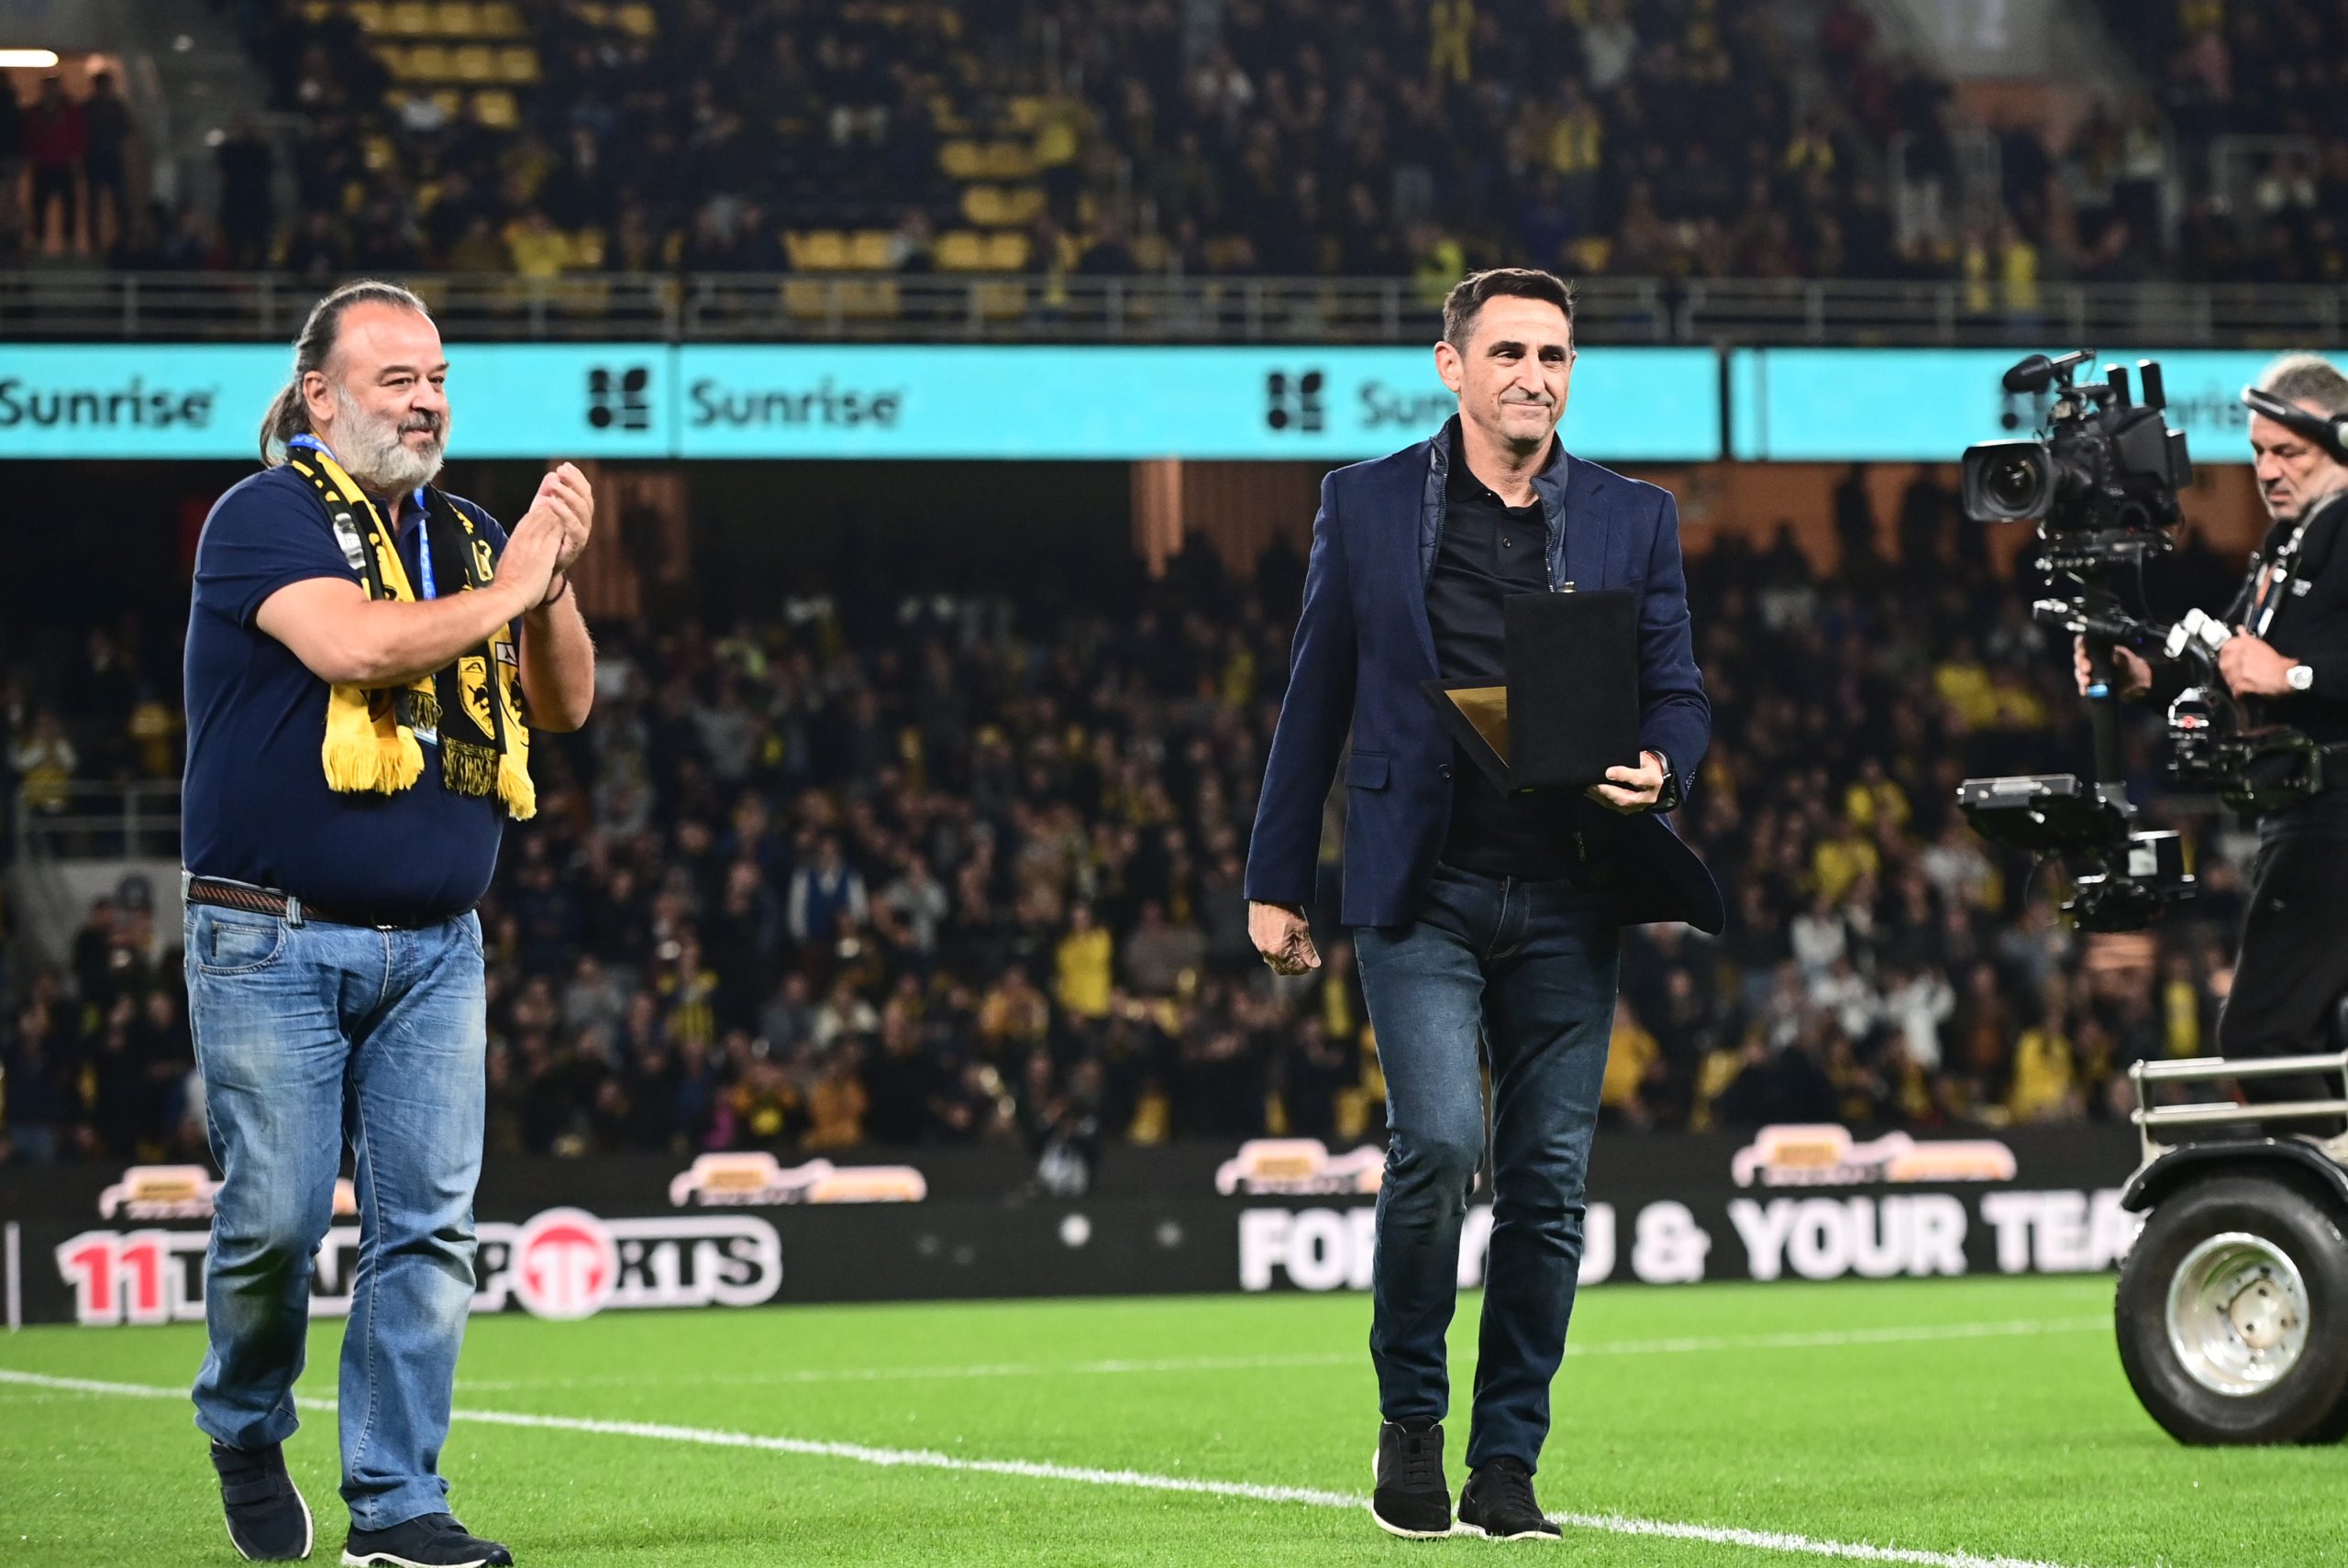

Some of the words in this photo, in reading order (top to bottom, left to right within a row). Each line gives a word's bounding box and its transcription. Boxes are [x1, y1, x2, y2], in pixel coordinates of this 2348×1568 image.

[0, 376, 216, 428] Sunrise
[690, 377, 903, 428] Sunrise
[1727, 1195, 1968, 1280] YOUR
[1980, 1189, 2143, 1273] TEA
